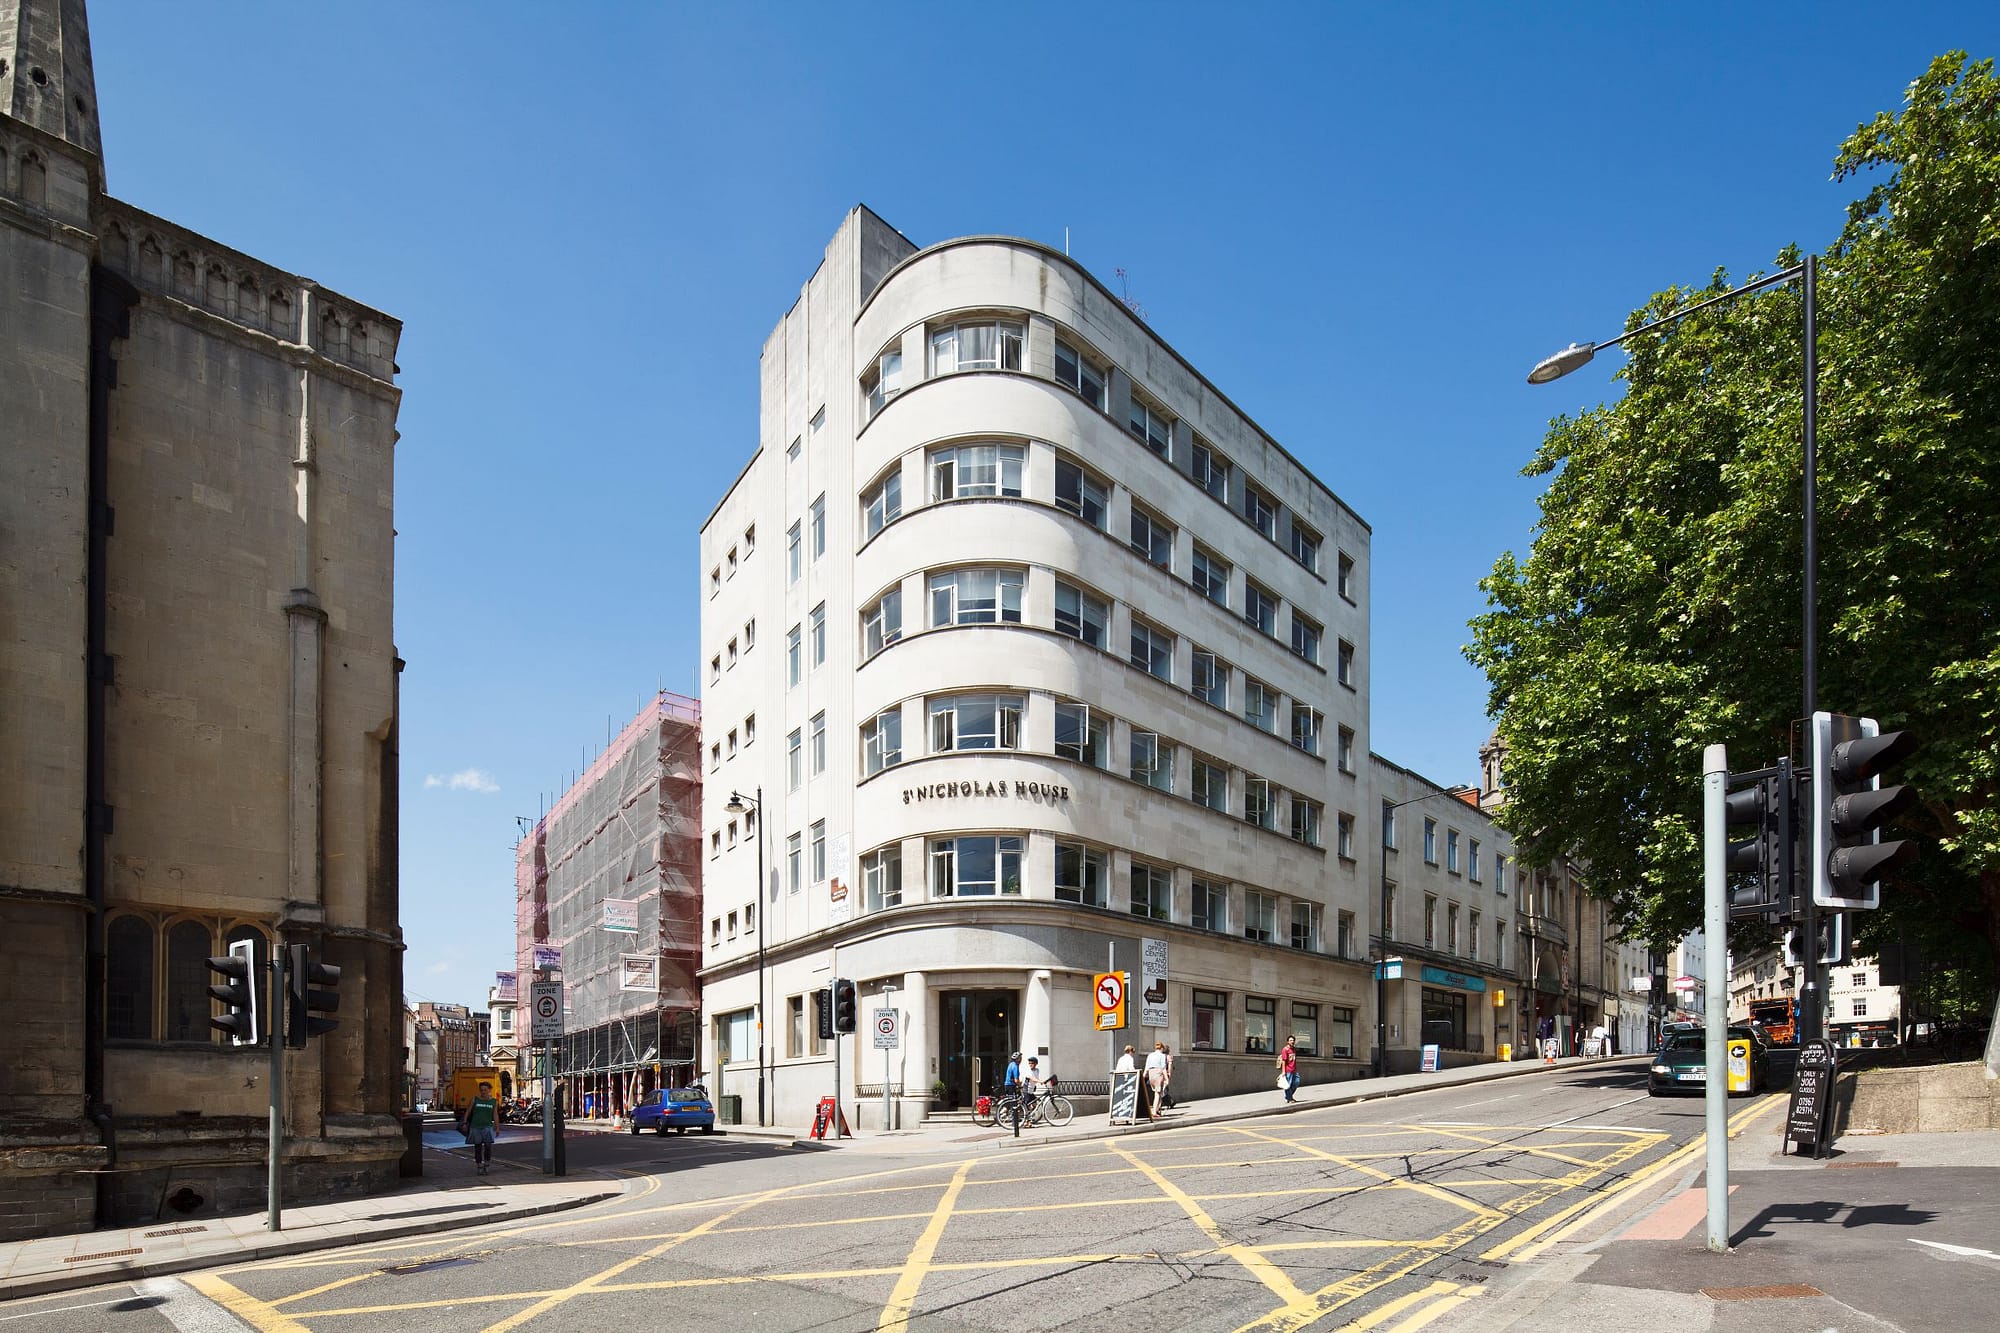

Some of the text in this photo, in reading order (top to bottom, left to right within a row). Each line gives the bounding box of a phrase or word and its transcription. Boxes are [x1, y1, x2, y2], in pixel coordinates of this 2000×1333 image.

[917, 781, 1007, 801] NICHOLAS
[1015, 781, 1069, 800] HOUSE
[1143, 1008, 1168, 1017] OFFICE
[1800, 1078, 1816, 1086] YOGA
